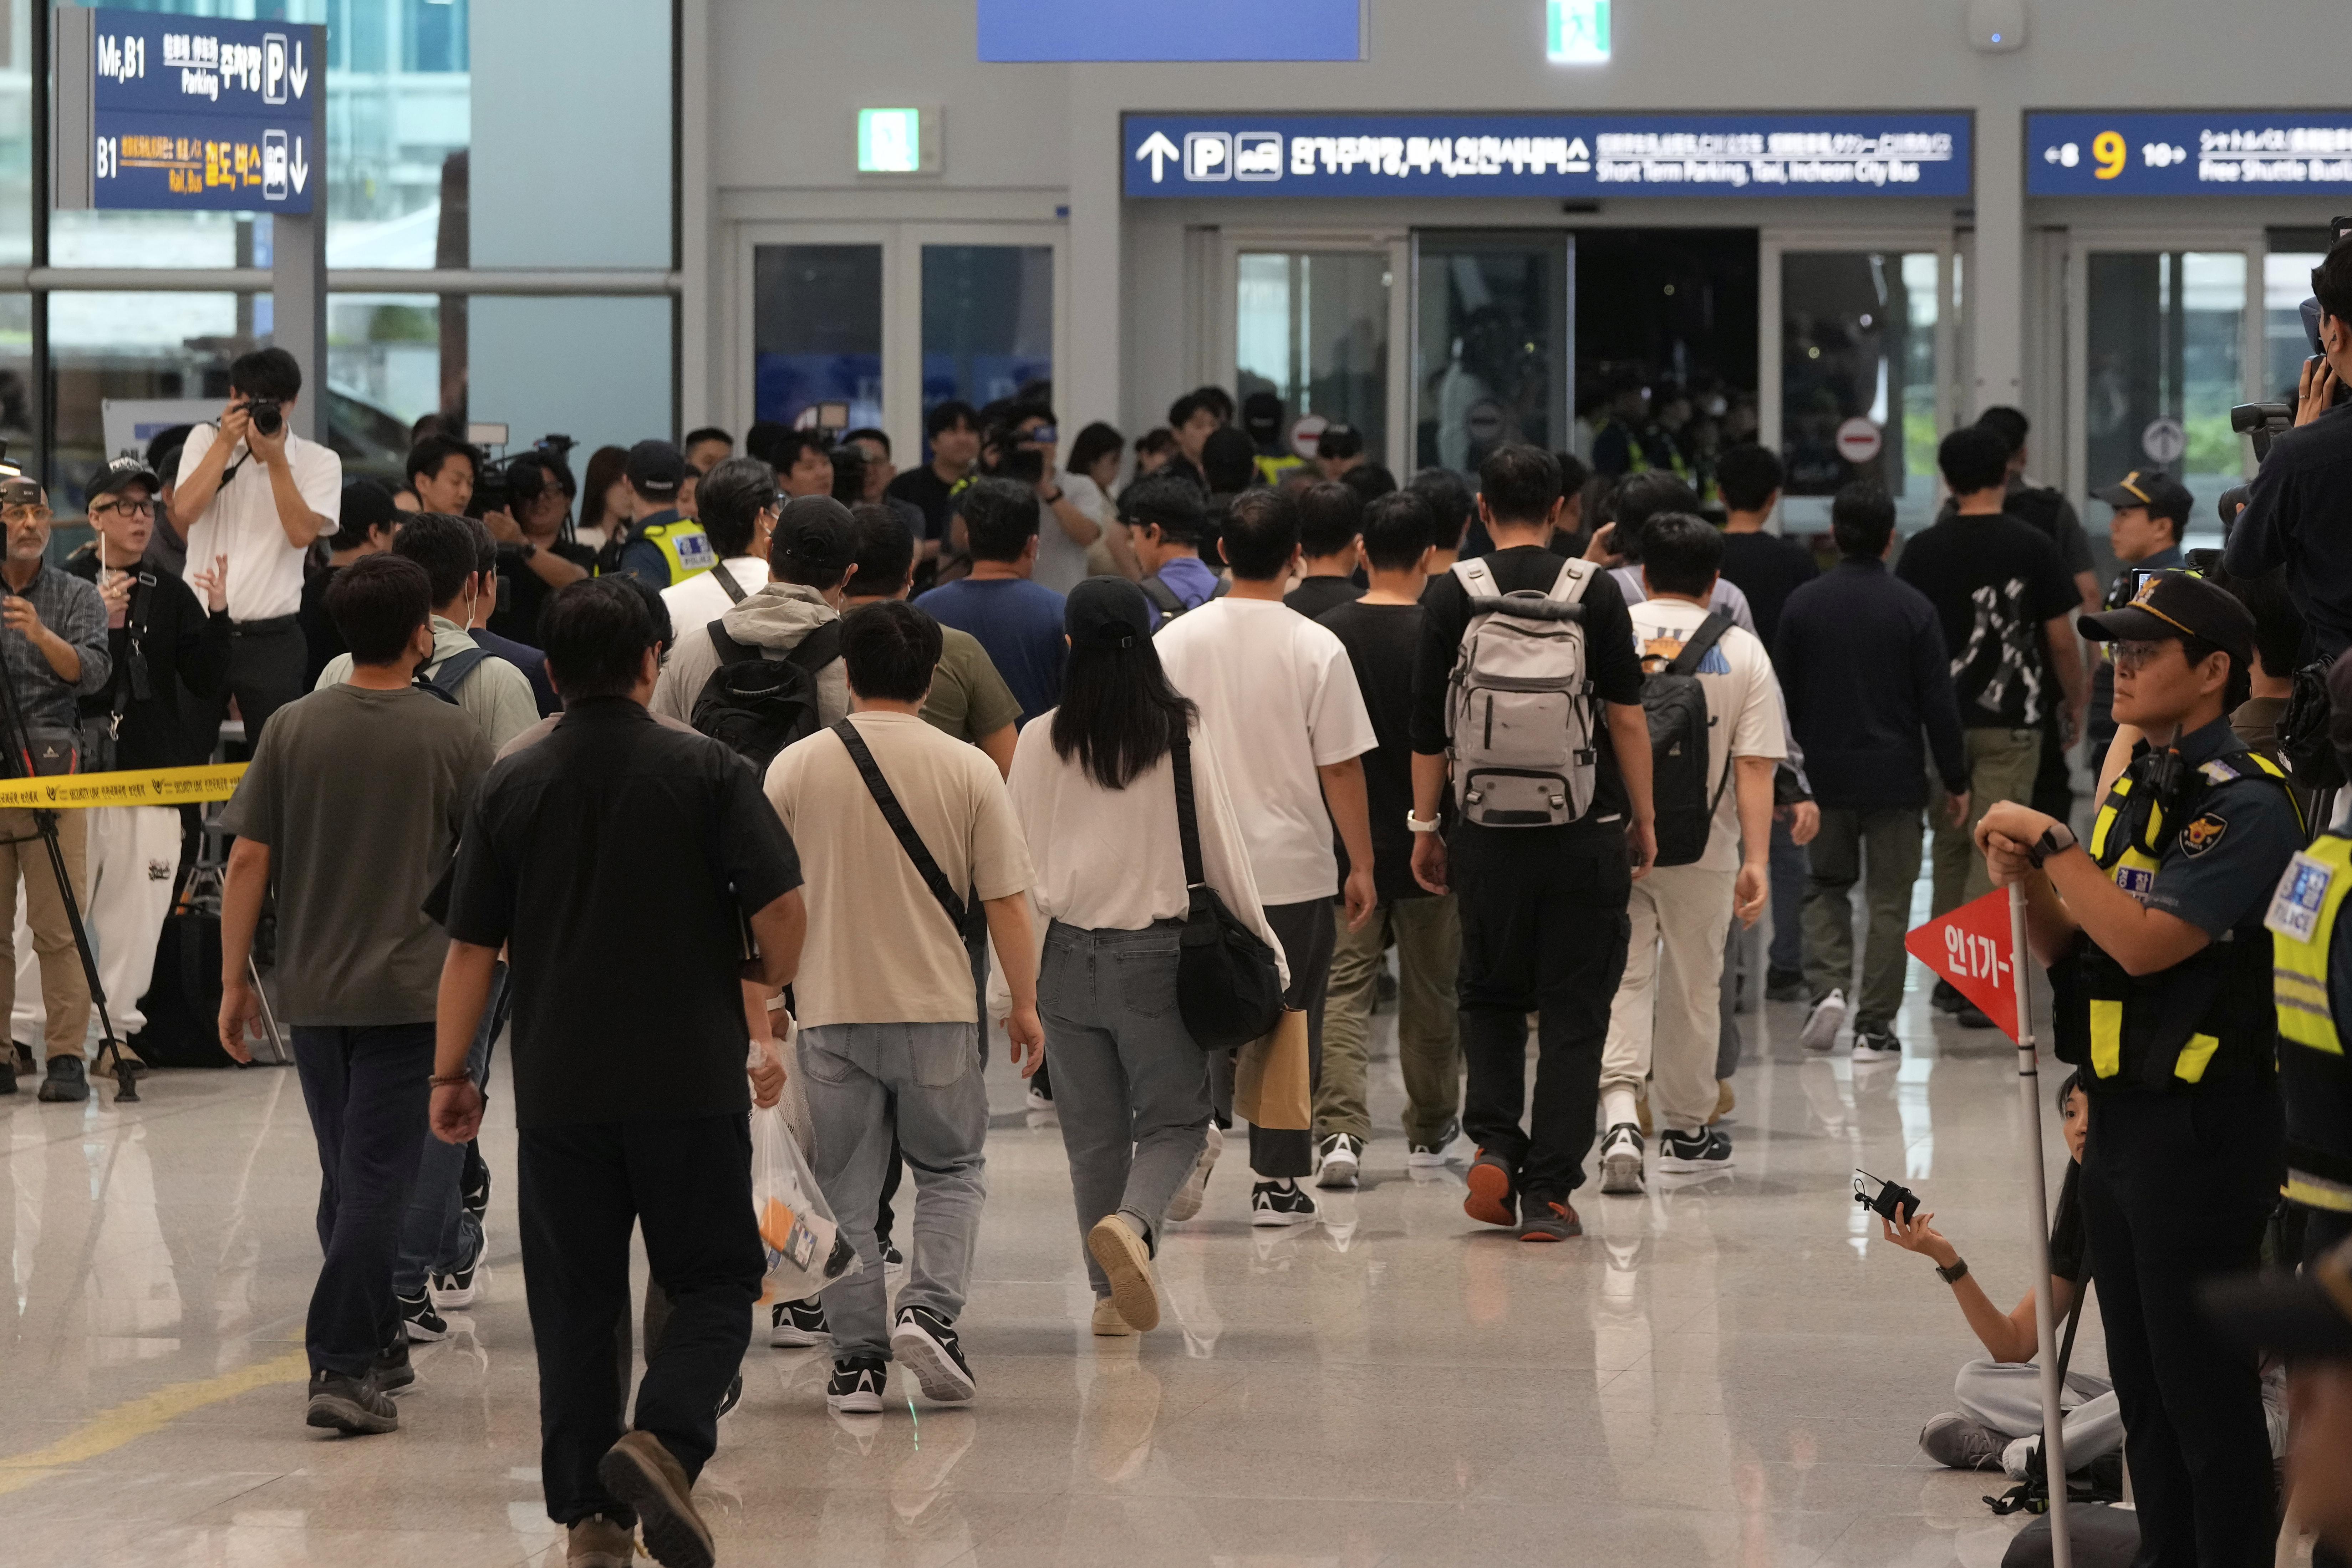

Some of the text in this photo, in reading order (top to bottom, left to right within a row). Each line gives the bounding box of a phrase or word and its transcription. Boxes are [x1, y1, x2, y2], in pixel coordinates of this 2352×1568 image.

[182, 68, 218, 102] Parking
[220, 43, 262, 92] 주차장
[96, 136, 117, 178] B1
[1643, 159, 1683, 182] Term
[1854, 160, 1888, 187] City
[1888, 159, 1920, 182] Bus
[2093, 131, 2127, 180] 9
[2142, 142, 2172, 168] 10
[2198, 159, 2241, 182] Free
[2241, 159, 2308, 182] Shuttle
